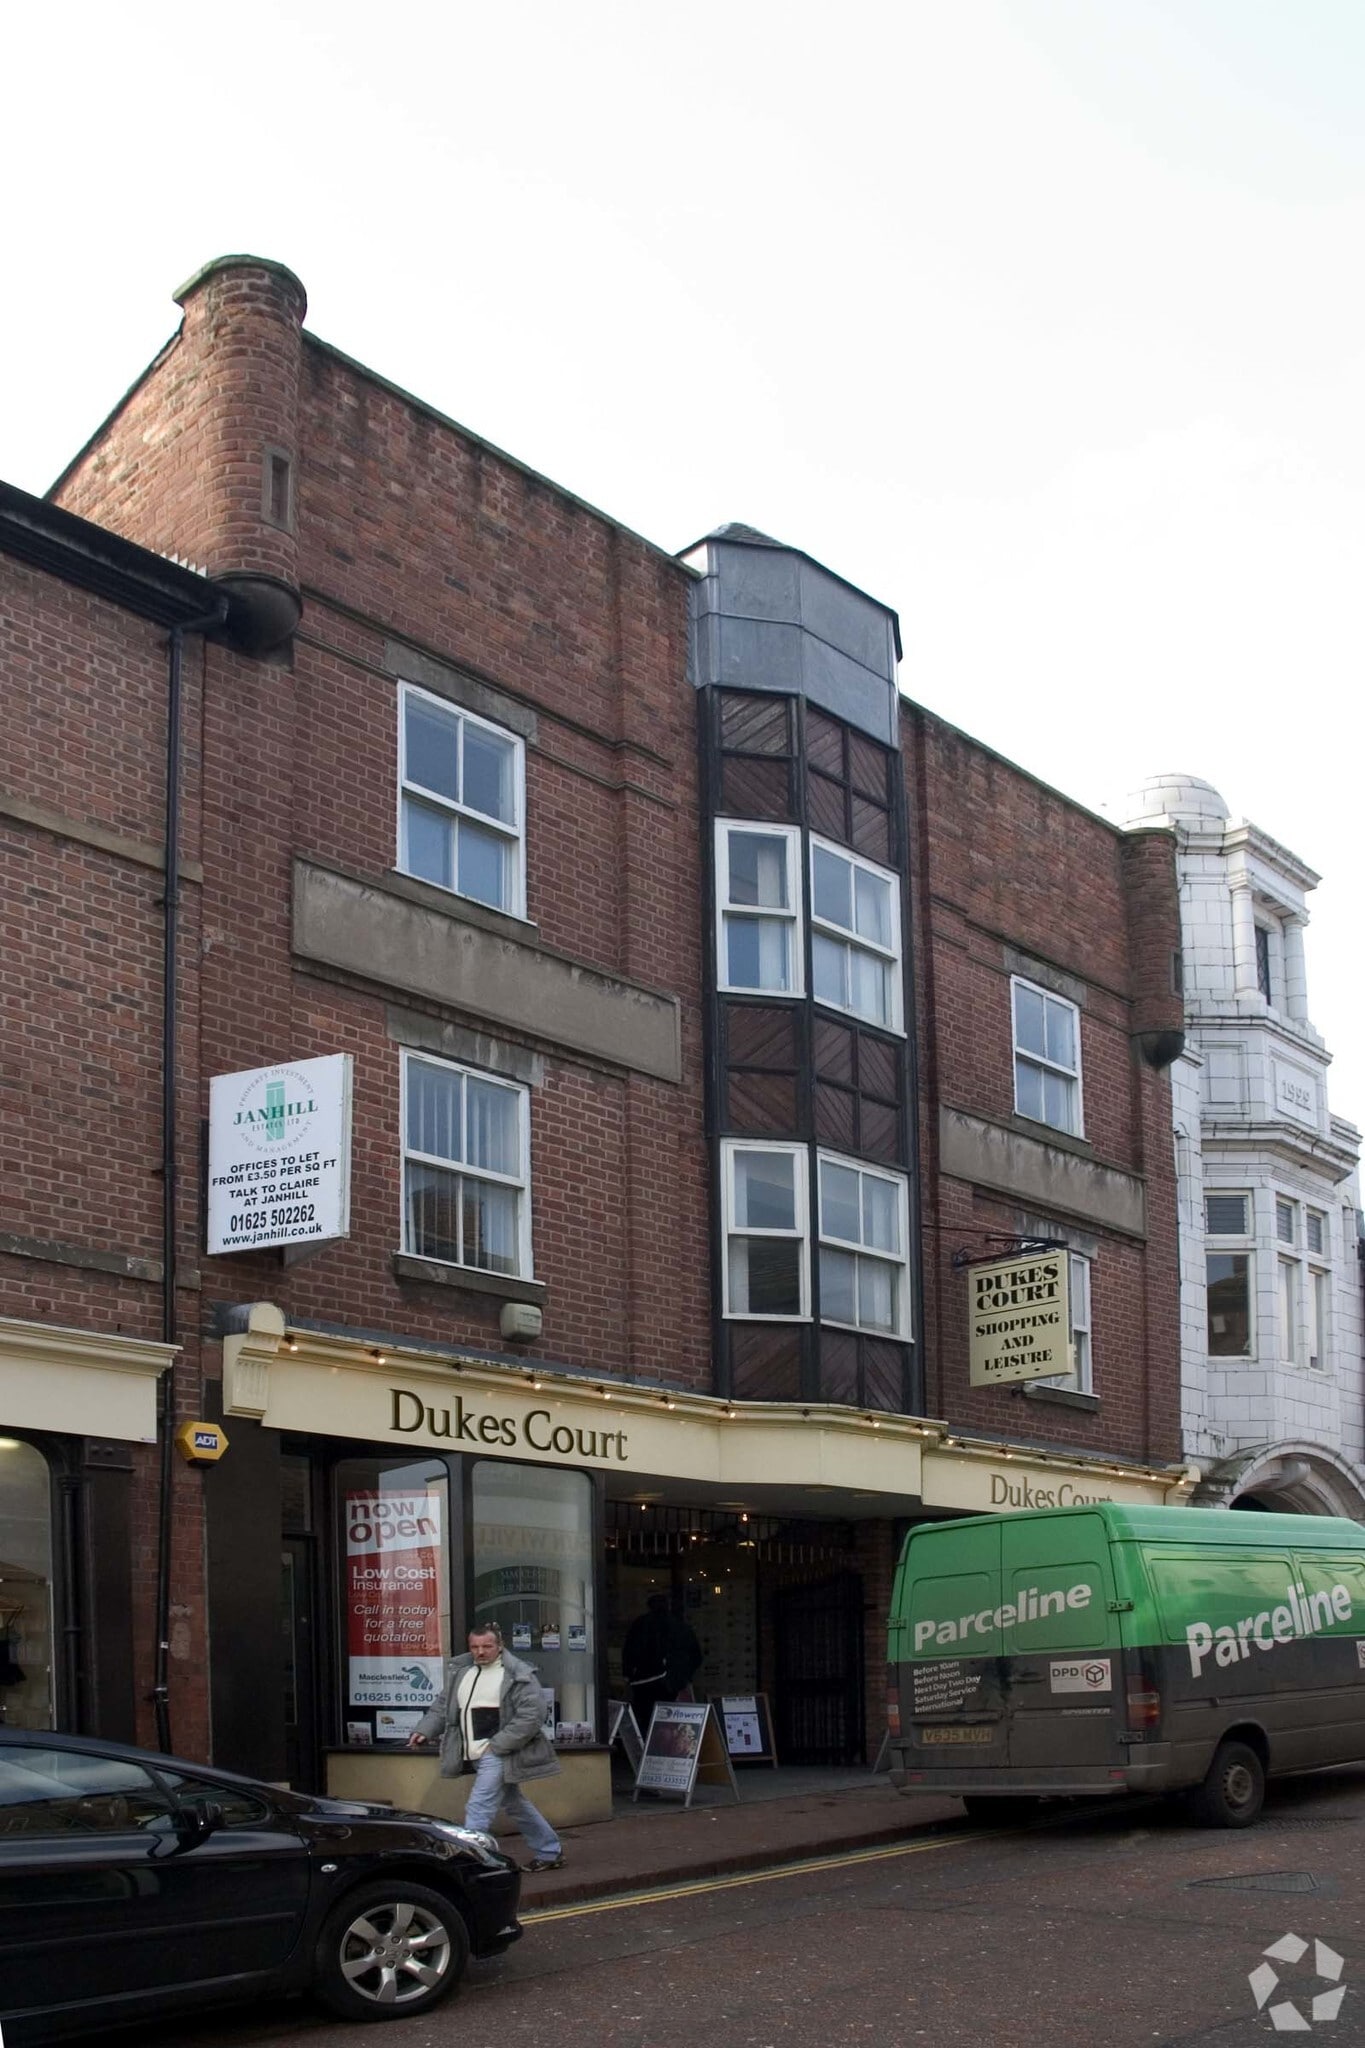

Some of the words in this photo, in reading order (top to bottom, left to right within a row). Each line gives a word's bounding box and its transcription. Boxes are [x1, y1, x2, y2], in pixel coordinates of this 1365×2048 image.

[233, 1100, 319, 1126] JANHILL
[230, 1159, 277, 1174] OFFICES
[281, 1156, 295, 1166] TO
[299, 1151, 320, 1163] LET
[212, 1174, 244, 1186] FROM
[247, 1169, 277, 1181] £3.50
[280, 1165, 301, 1176] PER
[305, 1162, 320, 1172] SQ
[323, 1159, 337, 1169] FT
[229, 1187, 257, 1198] TALK
[261, 1184, 276, 1194] TO
[279, 1177, 320, 1191] CLAIRE
[243, 1197, 258, 1207] AT
[261, 1190, 308, 1204] JANHILL
[230, 1211, 267, 1232] 01625
[271, 1204, 315, 1227] 502262
[222, 1223, 322, 1245] www.janhill.co.uk
[976, 1263, 1058, 1293] DUKES
[976, 1281, 1059, 1310] COURT
[975, 1311, 1060, 1337] SHOPPING
[1001, 1335, 1034, 1350] AND
[984, 1349, 1052, 1371] LEISURE
[196, 1436, 218, 1446] ADT
[351, 1502, 415, 1520] now
[349, 1517, 438, 1548] open
[353, 1566, 390, 1579] Low
[394, 1566, 436, 1579] Cost
[353, 1580, 424, 1591] Insurance
[353, 1604, 379, 1615] Call
[382, 1604, 394, 1615] in
[398, 1604, 435, 1617] today
[914, 1583, 1093, 1652] Parceline
[365, 1618, 383, 1629] for
[386, 1621, 395, 1629] a
[399, 1618, 424, 1629] free
[1186, 1582, 1353, 1679] Parceline
[363, 1632, 426, 1643] quotation
[359, 1673, 410, 1681] Macclesfield
[913, 1666, 938, 1676] Before
[940, 1661, 960, 1671] 10am
[1052, 1667, 1079, 1678] DPD
[914, 1675, 938, 1686] Before
[939, 1670, 961, 1680] Noon
[914, 1685, 932, 1695] Next
[933, 1682, 948, 1692] Day
[948, 1679, 964, 1688] Two
[965, 1675, 982, 1685] Day
[354, 1692, 391, 1702] 01625
[914, 1691, 949, 1705] Saturday
[949, 1686, 977, 1698] Service
[914, 1697, 964, 1714] International
